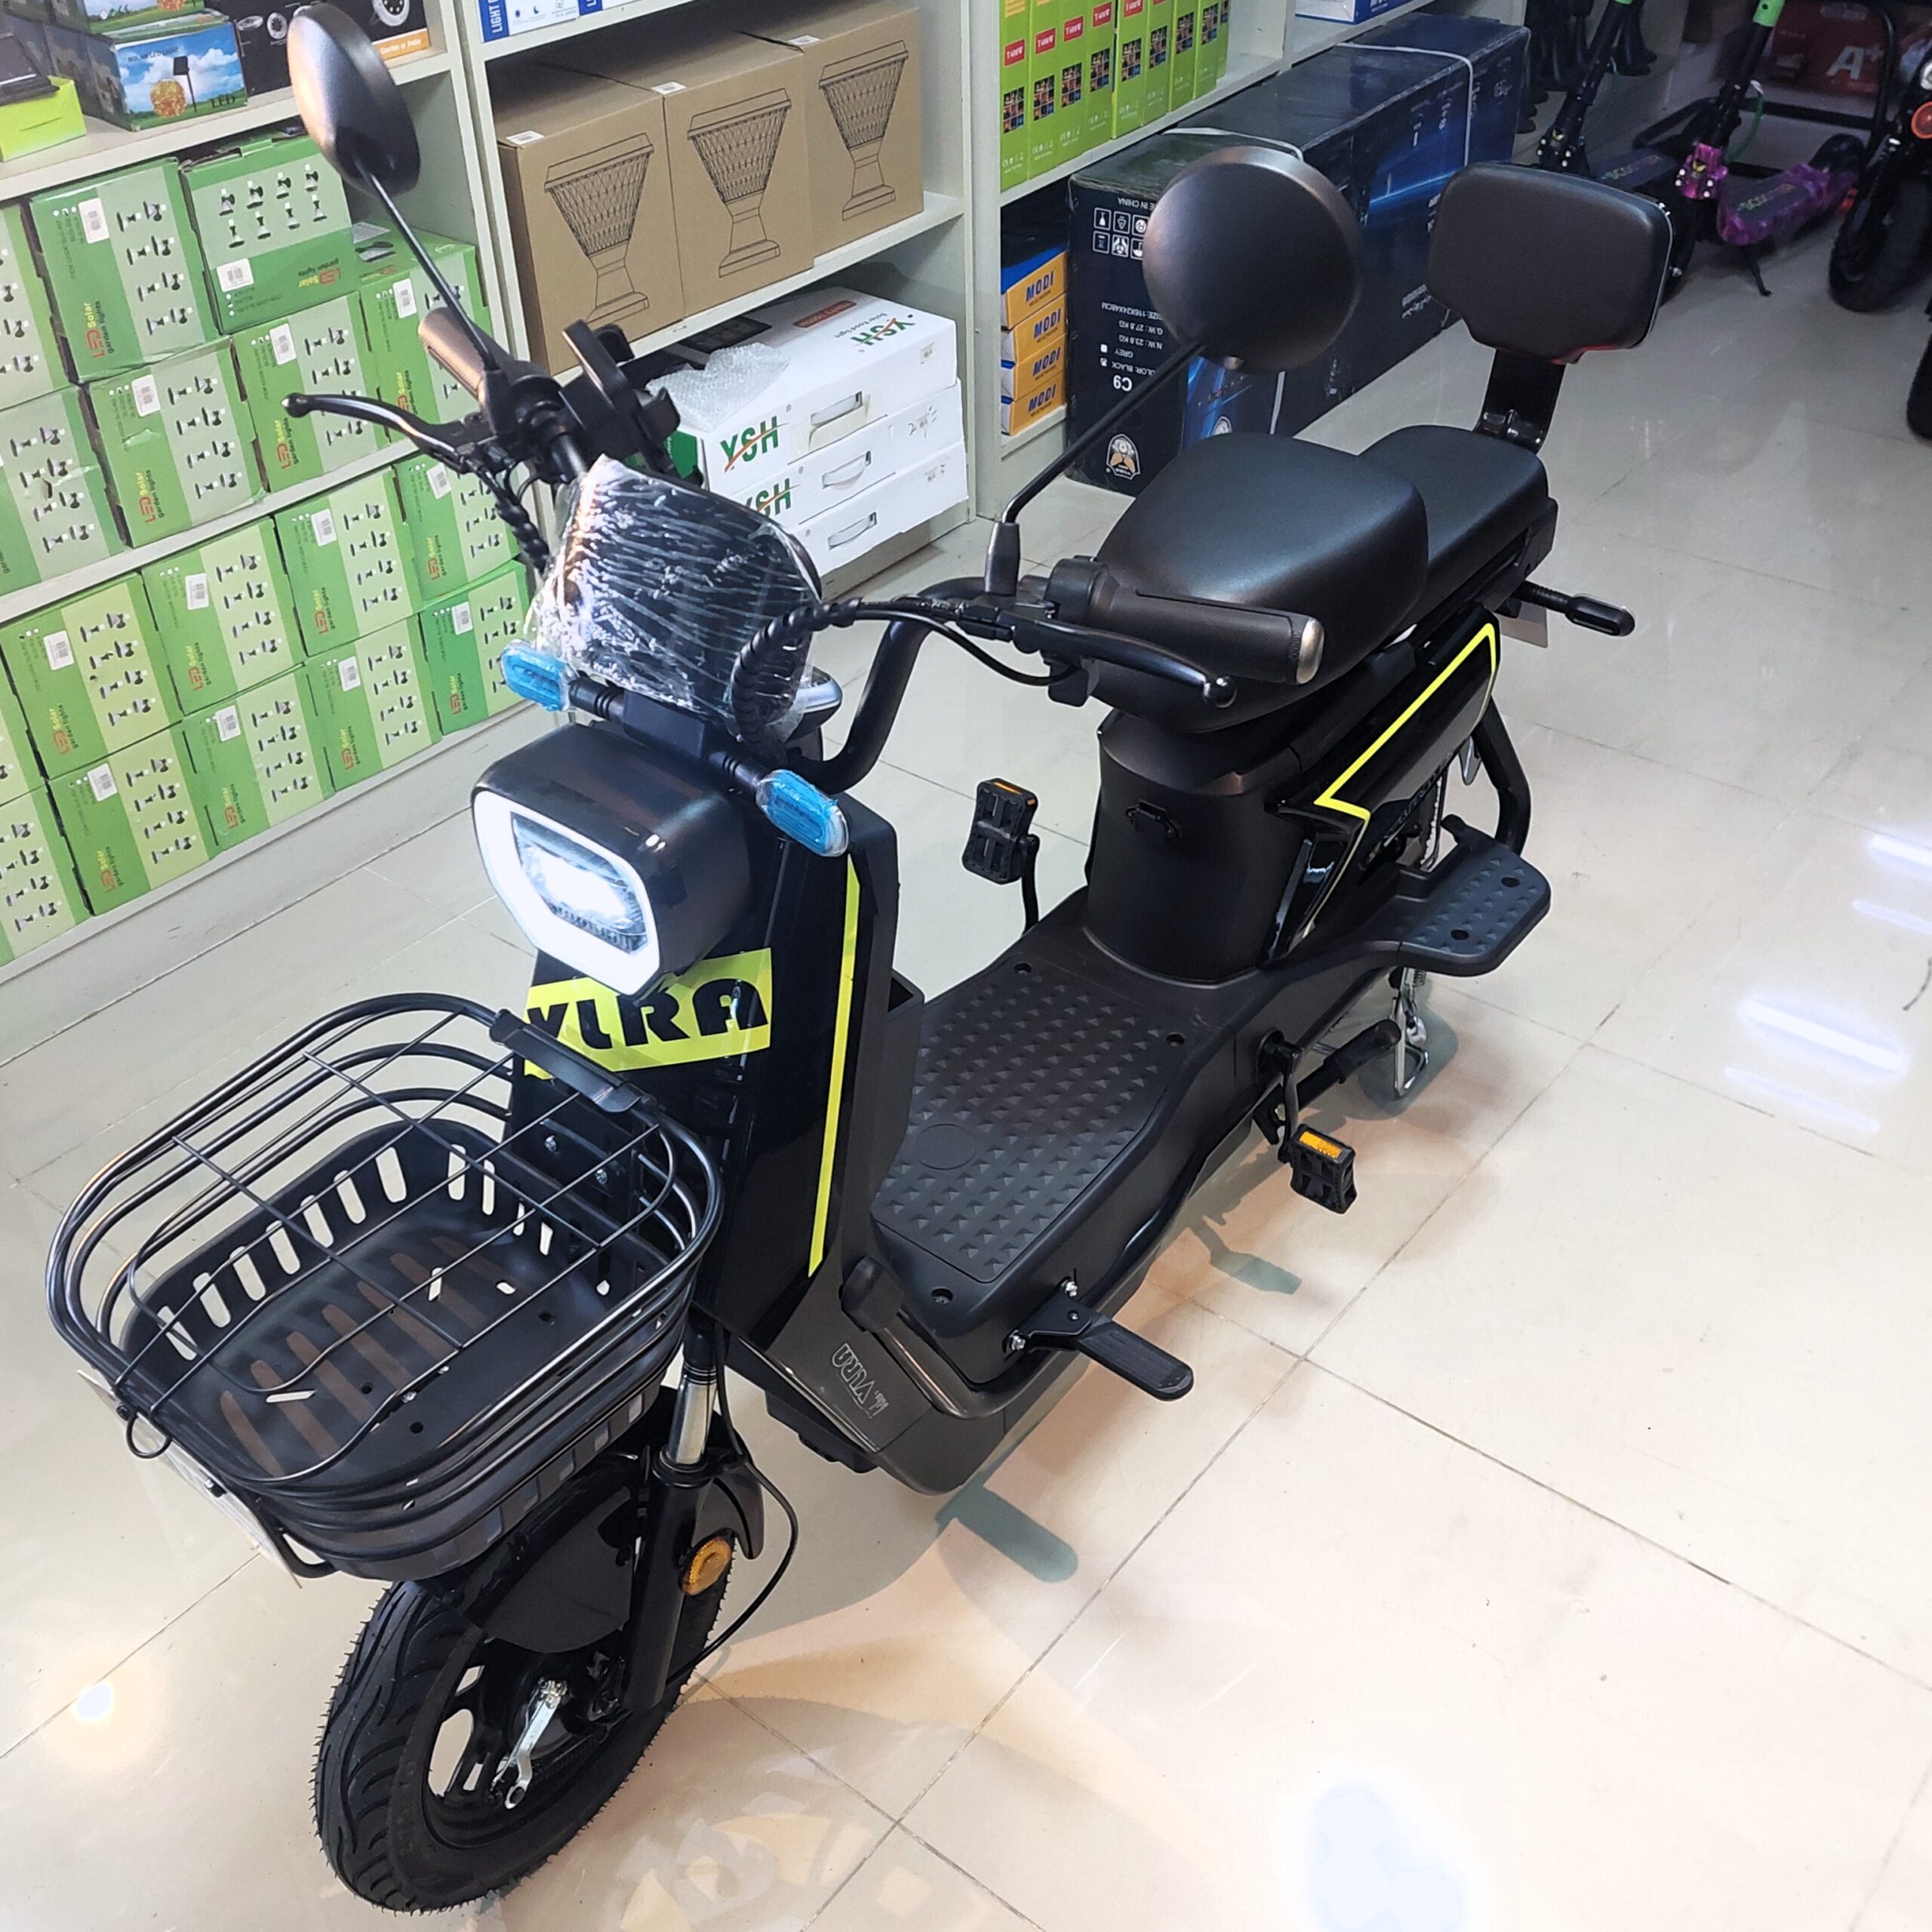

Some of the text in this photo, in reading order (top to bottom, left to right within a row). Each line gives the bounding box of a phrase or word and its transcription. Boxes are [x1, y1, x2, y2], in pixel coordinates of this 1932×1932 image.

[488, 6, 503, 33] LIGHT
[211, 94, 235, 108] LED
[1117, 197, 1140, 208] CHINA
[317, 257, 339, 270] garden
[298, 267, 341, 288] LED Solar
[1026, 270, 1054, 303] MODI
[84, 302, 105, 358] LED Solar
[95, 300, 115, 354] garden lights
[850, 318, 916, 346] YSH
[1033, 308, 1061, 339] MODI
[1118, 320, 1129, 328] KG
[1118, 334, 1129, 343] KG
[1032, 346, 1061, 377] MODI
[1114, 348, 1134, 358] GREY
[1112, 361, 1133, 373] BLACK
[396, 372, 405, 394] Solar
[1113, 375, 1133, 392] C9
[1028, 383, 1057, 413] MODI
[274, 420, 291, 469] LED Solar
[284, 417, 299, 465] garden lights
[719, 416, 780, 473] YSH
[136, 472, 156, 523] LED Solar
[146, 469, 165, 518] garden lights
[428, 557, 440, 580] LED
[315, 611, 328, 635] LED
[189, 666, 204, 691] LED
[450, 694, 462, 715] LED
[49, 708, 60, 730] Solar
[66, 724, 78, 749] garden
